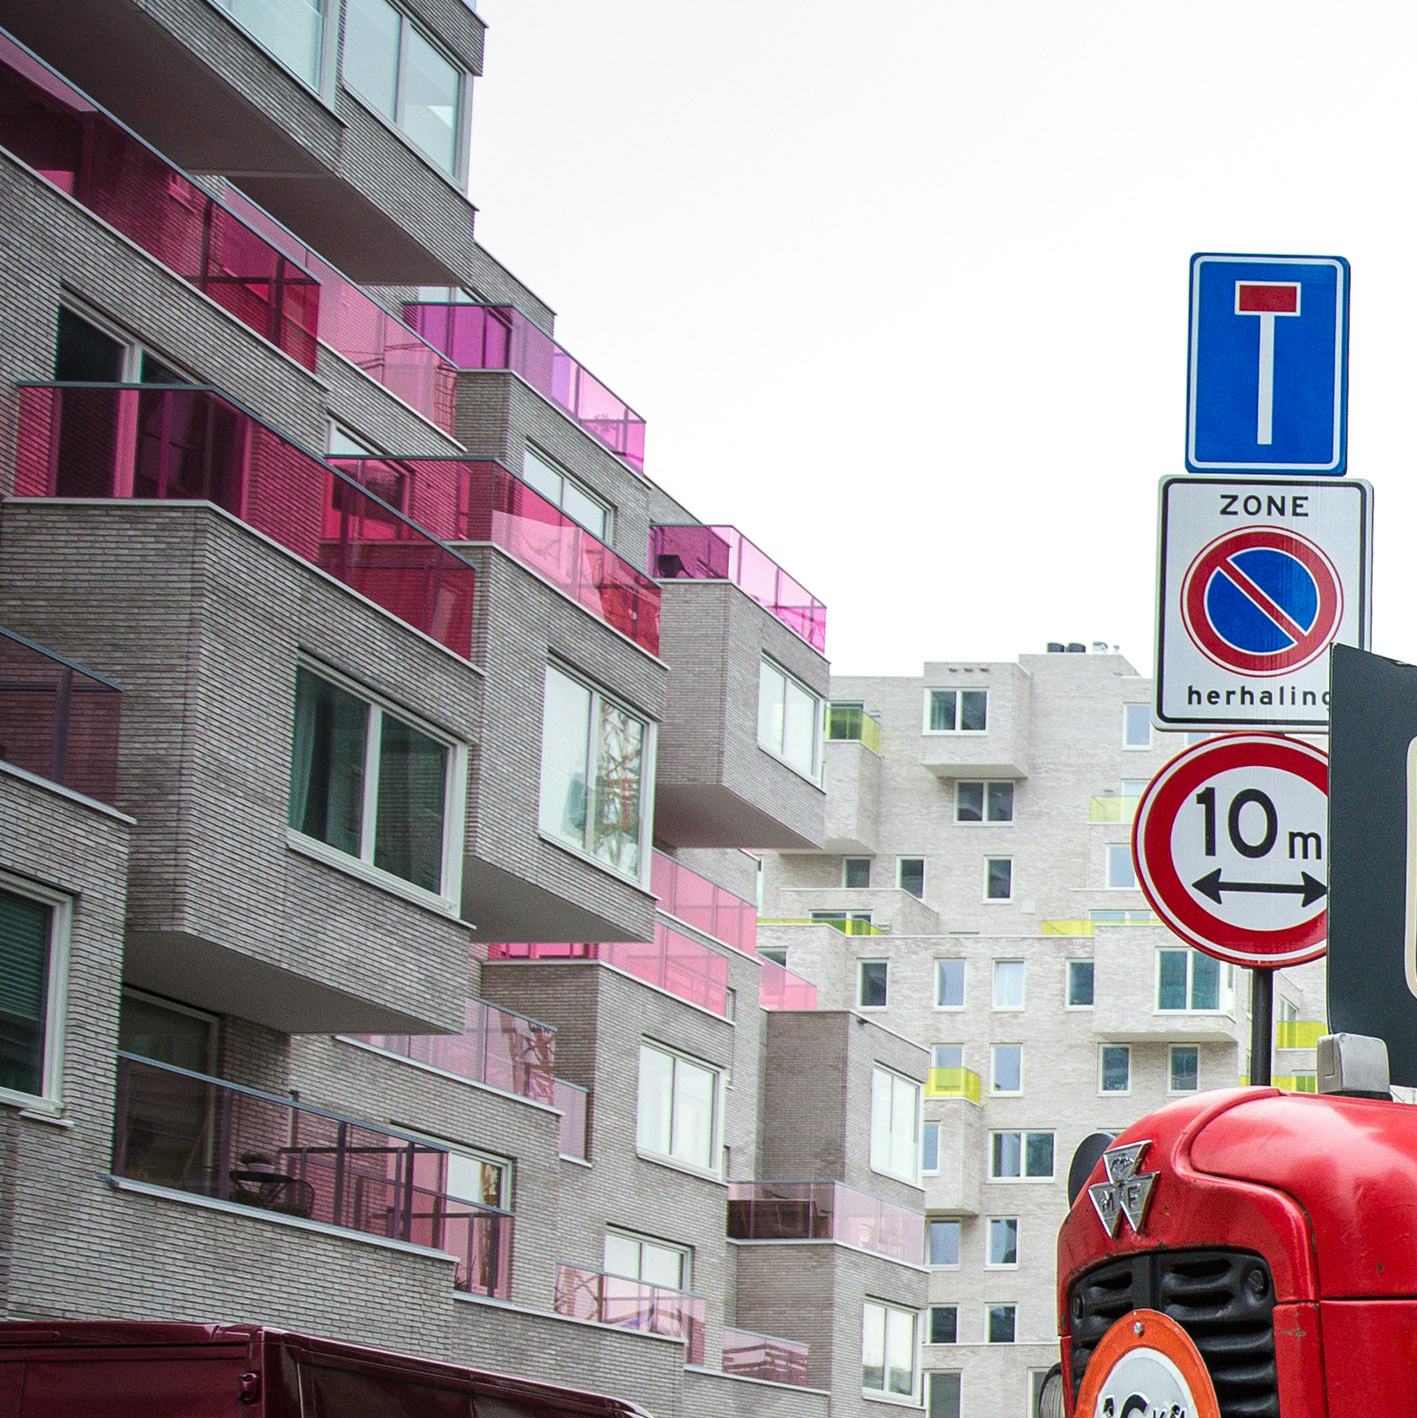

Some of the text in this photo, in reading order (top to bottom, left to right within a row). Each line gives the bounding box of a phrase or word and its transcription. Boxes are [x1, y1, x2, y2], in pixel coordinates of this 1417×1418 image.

[1219, 493, 1310, 518] ZONE
[1196, 786, 1322, 860] 10 m
